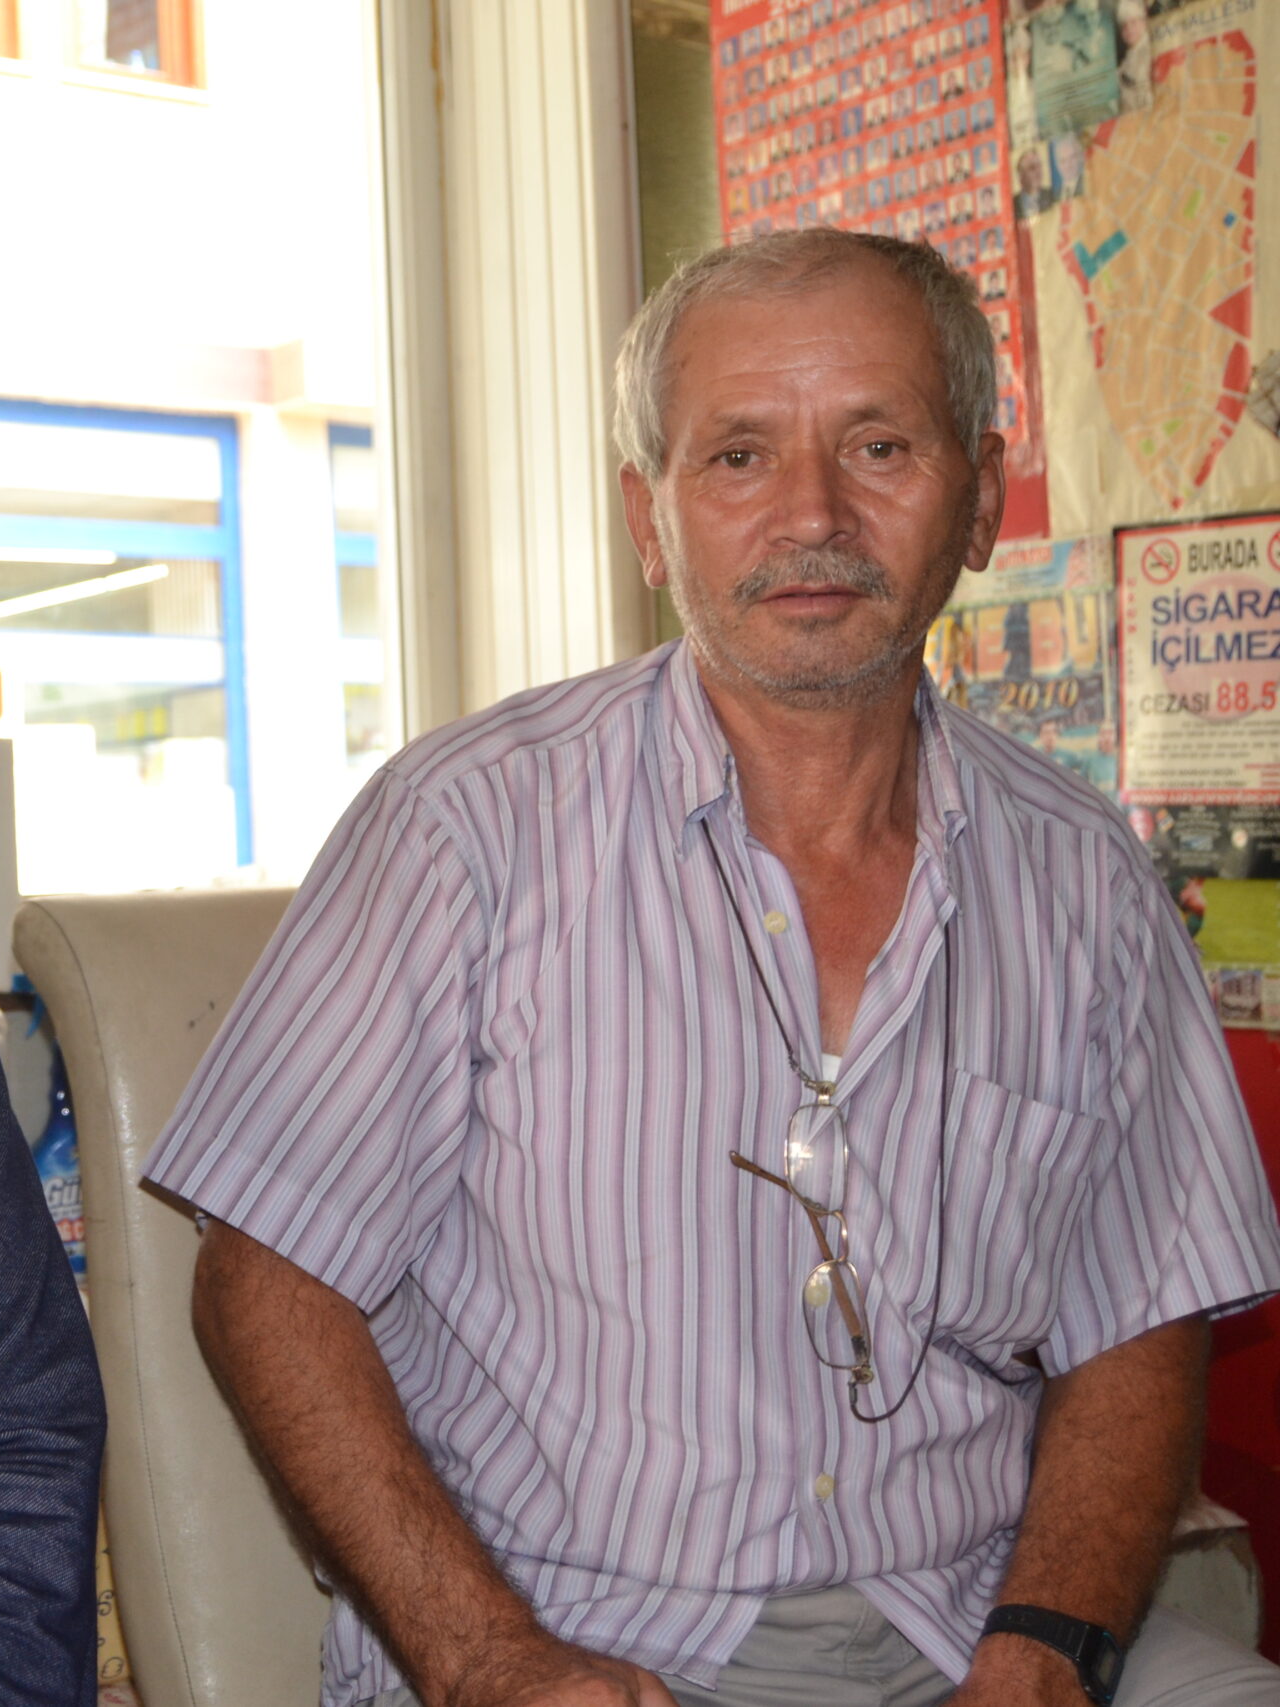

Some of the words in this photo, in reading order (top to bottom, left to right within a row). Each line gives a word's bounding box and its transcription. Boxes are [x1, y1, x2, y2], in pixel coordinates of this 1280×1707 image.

[1188, 539, 1258, 573] BURADA
[1151, 587, 1280, 626] SİGARA
[999, 677, 1079, 713] 2010
[1139, 692, 1210, 714] CEZASI
